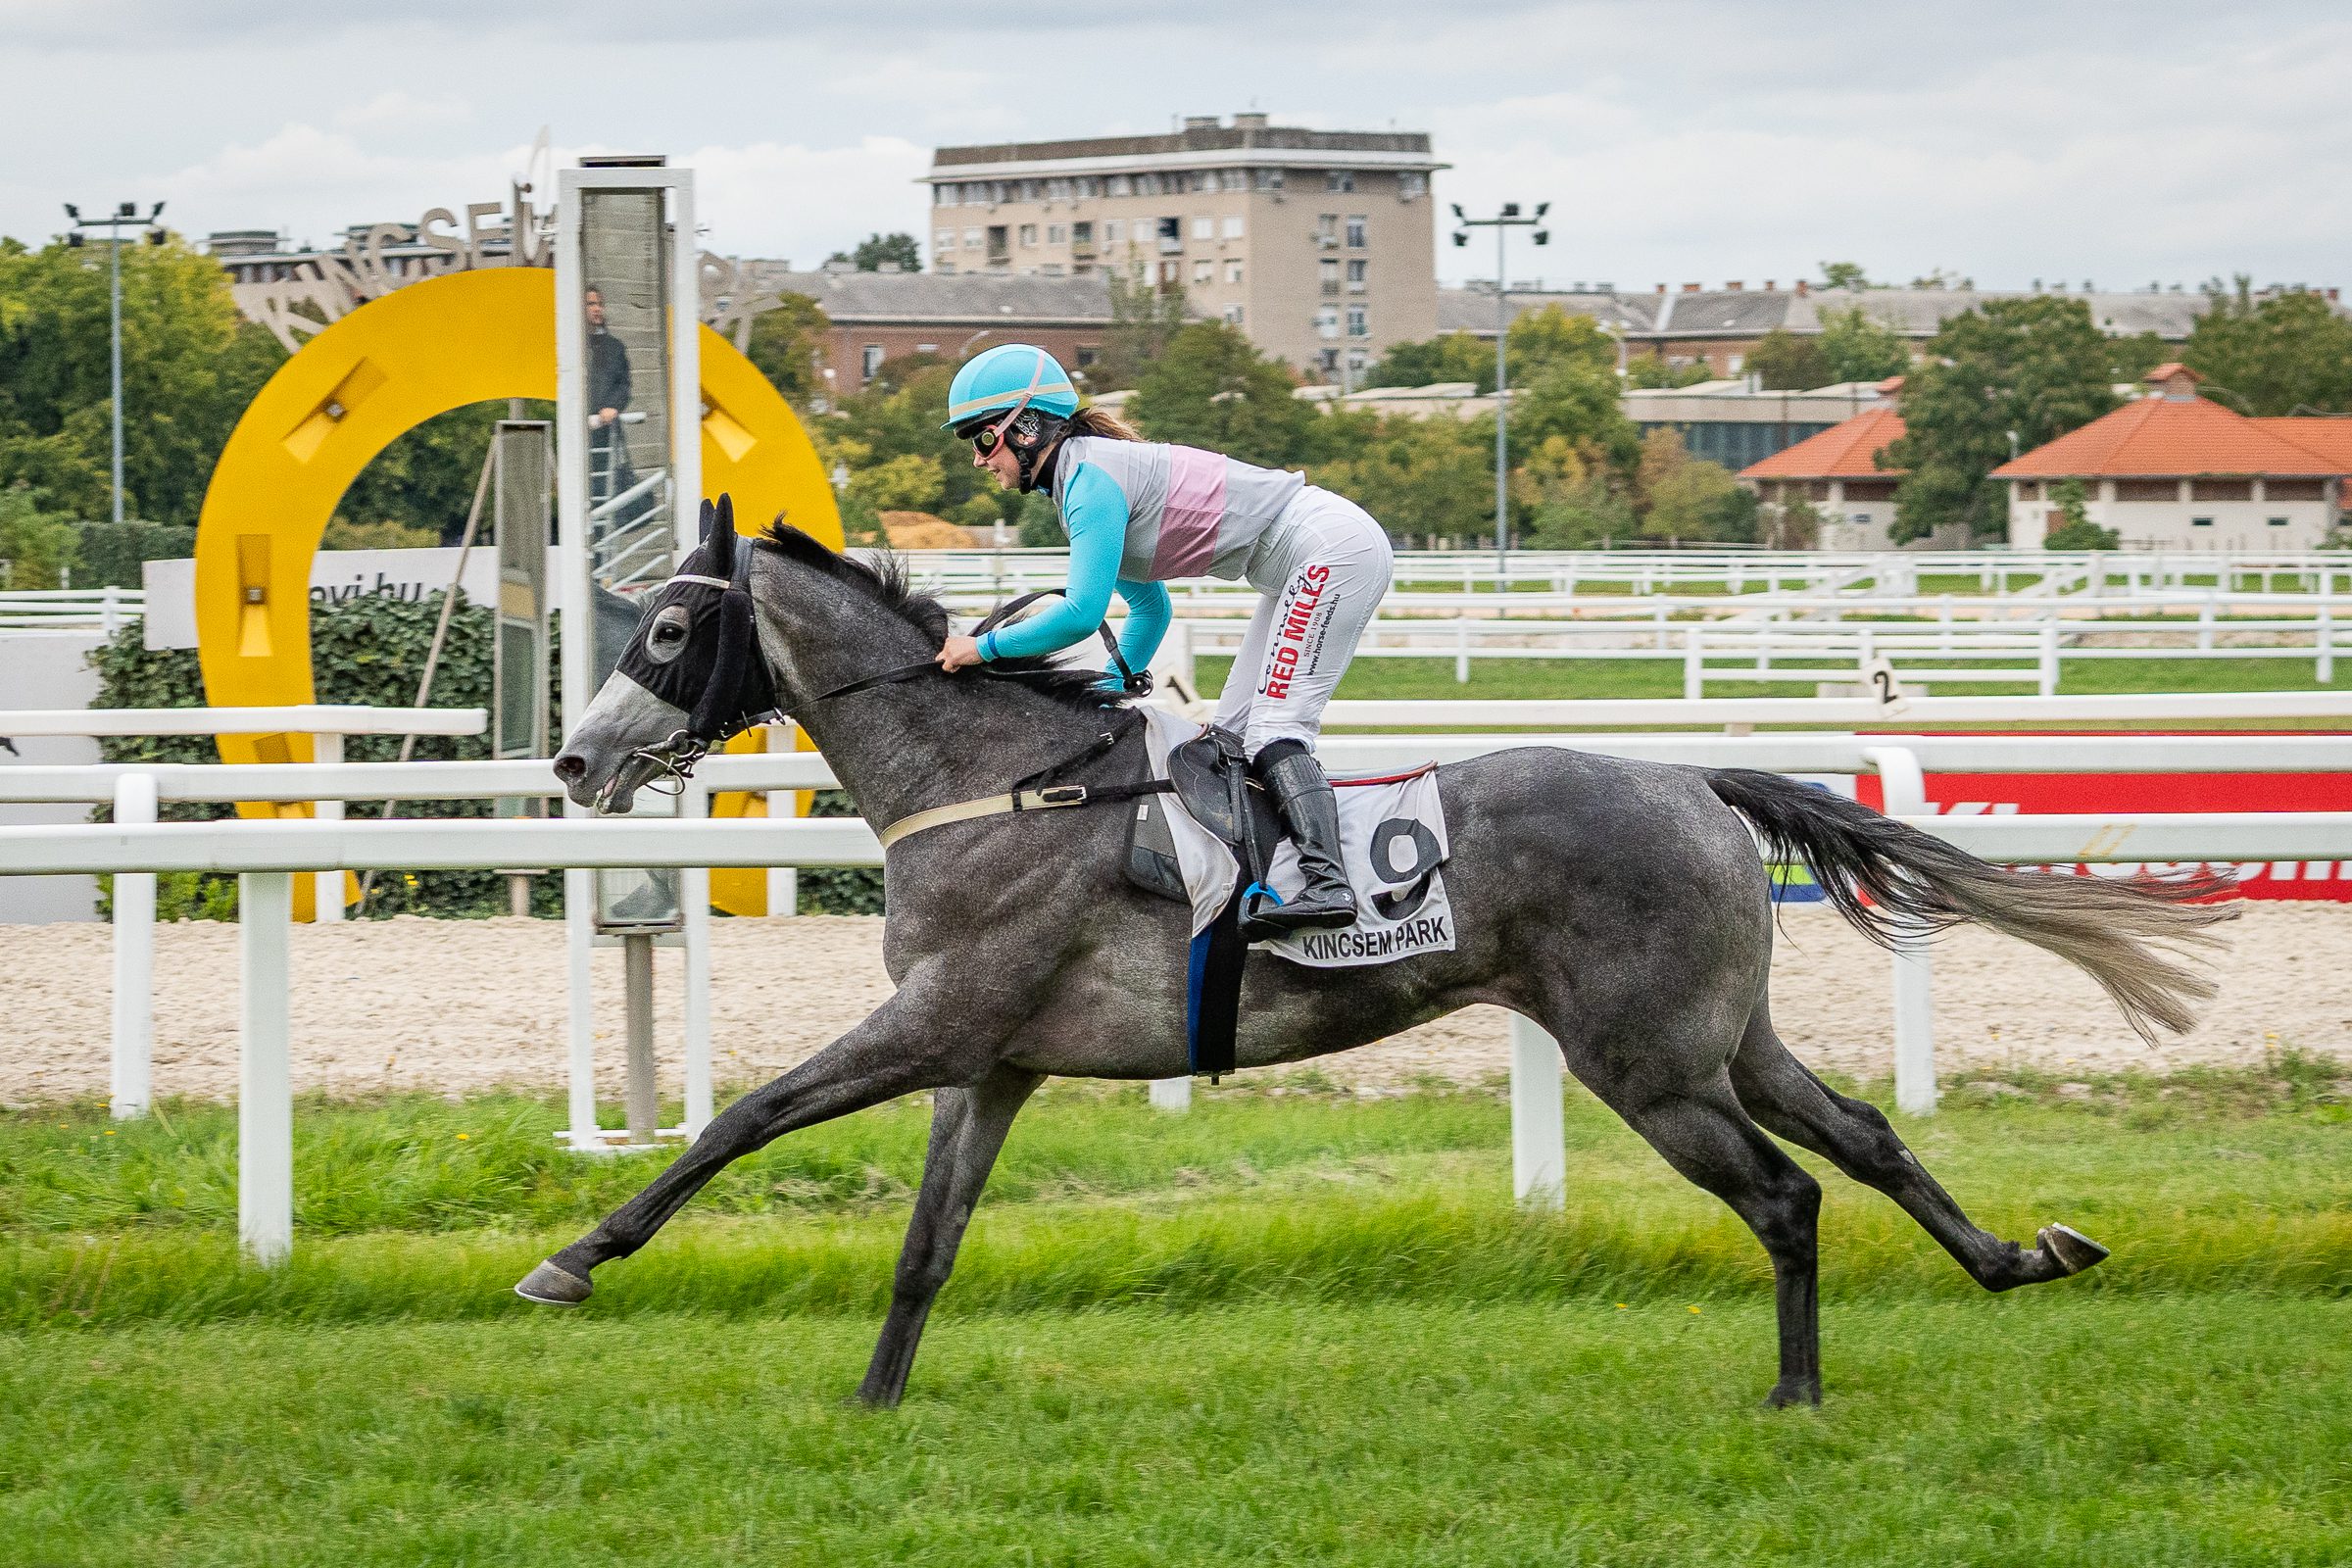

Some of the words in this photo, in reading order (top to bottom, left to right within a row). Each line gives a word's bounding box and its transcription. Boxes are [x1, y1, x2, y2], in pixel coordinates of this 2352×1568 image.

[1266, 646, 1299, 700] RED
[1284, 564, 1330, 642] MILLS
[1303, 631, 1315, 658] SINCE
[1311, 612, 1323, 631] 1908
[1306, 593, 1341, 676] www.horse-feeds.hu
[1165, 674, 1191, 705] 1
[1873, 669, 1898, 705] 2
[1370, 817, 1443, 921] 9
[1301, 933, 1393, 960] KINCSEM
[1395, 915, 1448, 951] PARK
